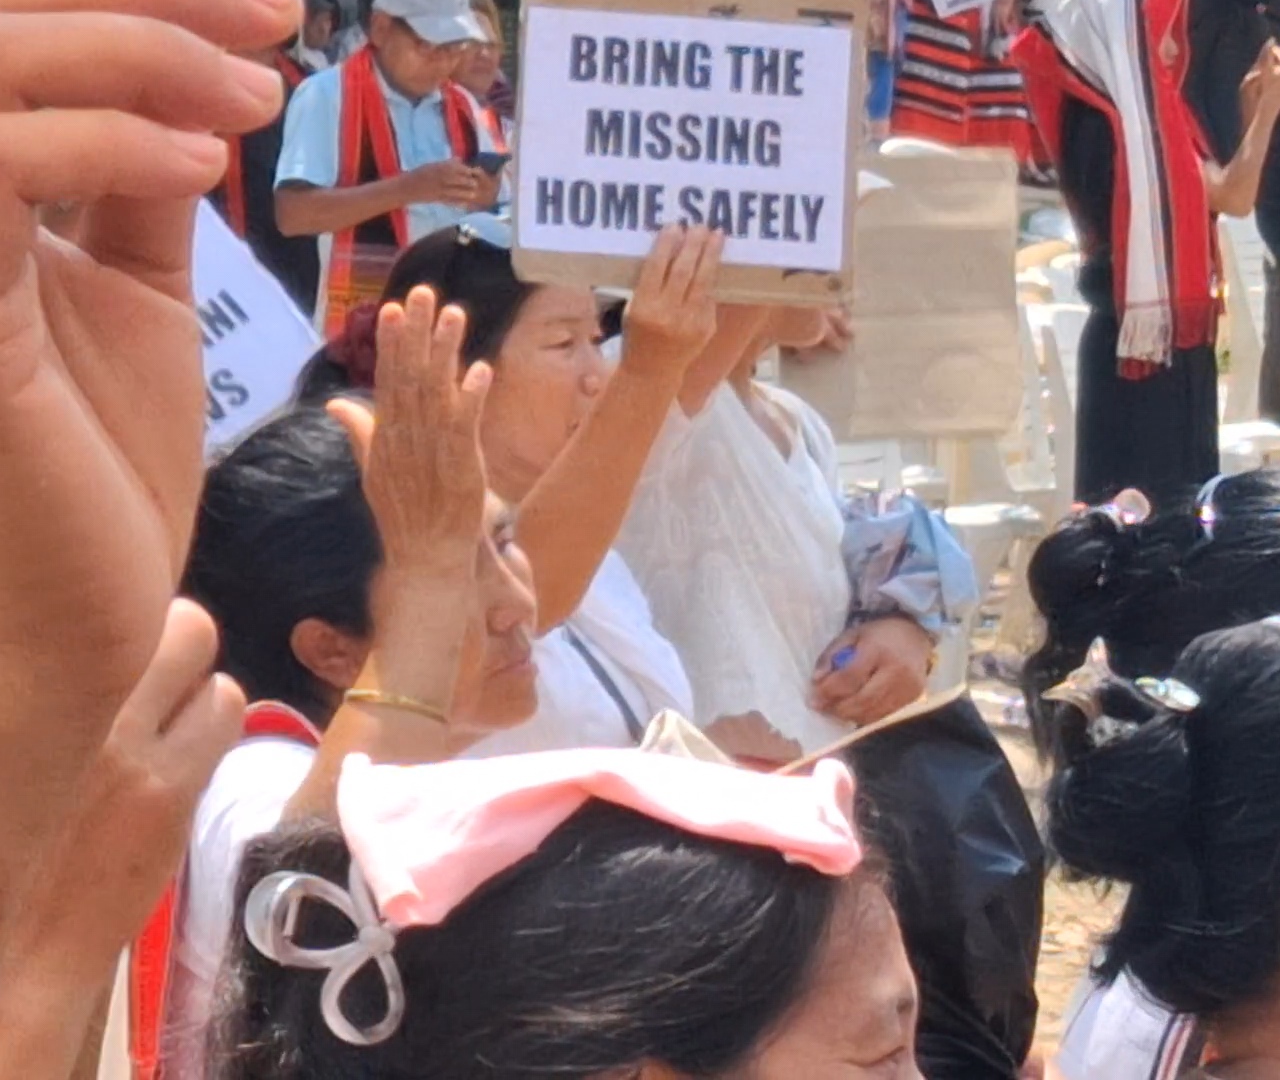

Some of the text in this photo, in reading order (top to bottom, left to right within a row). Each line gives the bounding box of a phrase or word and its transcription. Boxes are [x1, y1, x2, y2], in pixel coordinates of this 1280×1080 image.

[568, 33, 805, 97] BRING THE
[584, 108, 783, 168] MISSING
[535, 176, 825, 244] HOME SAFELY
